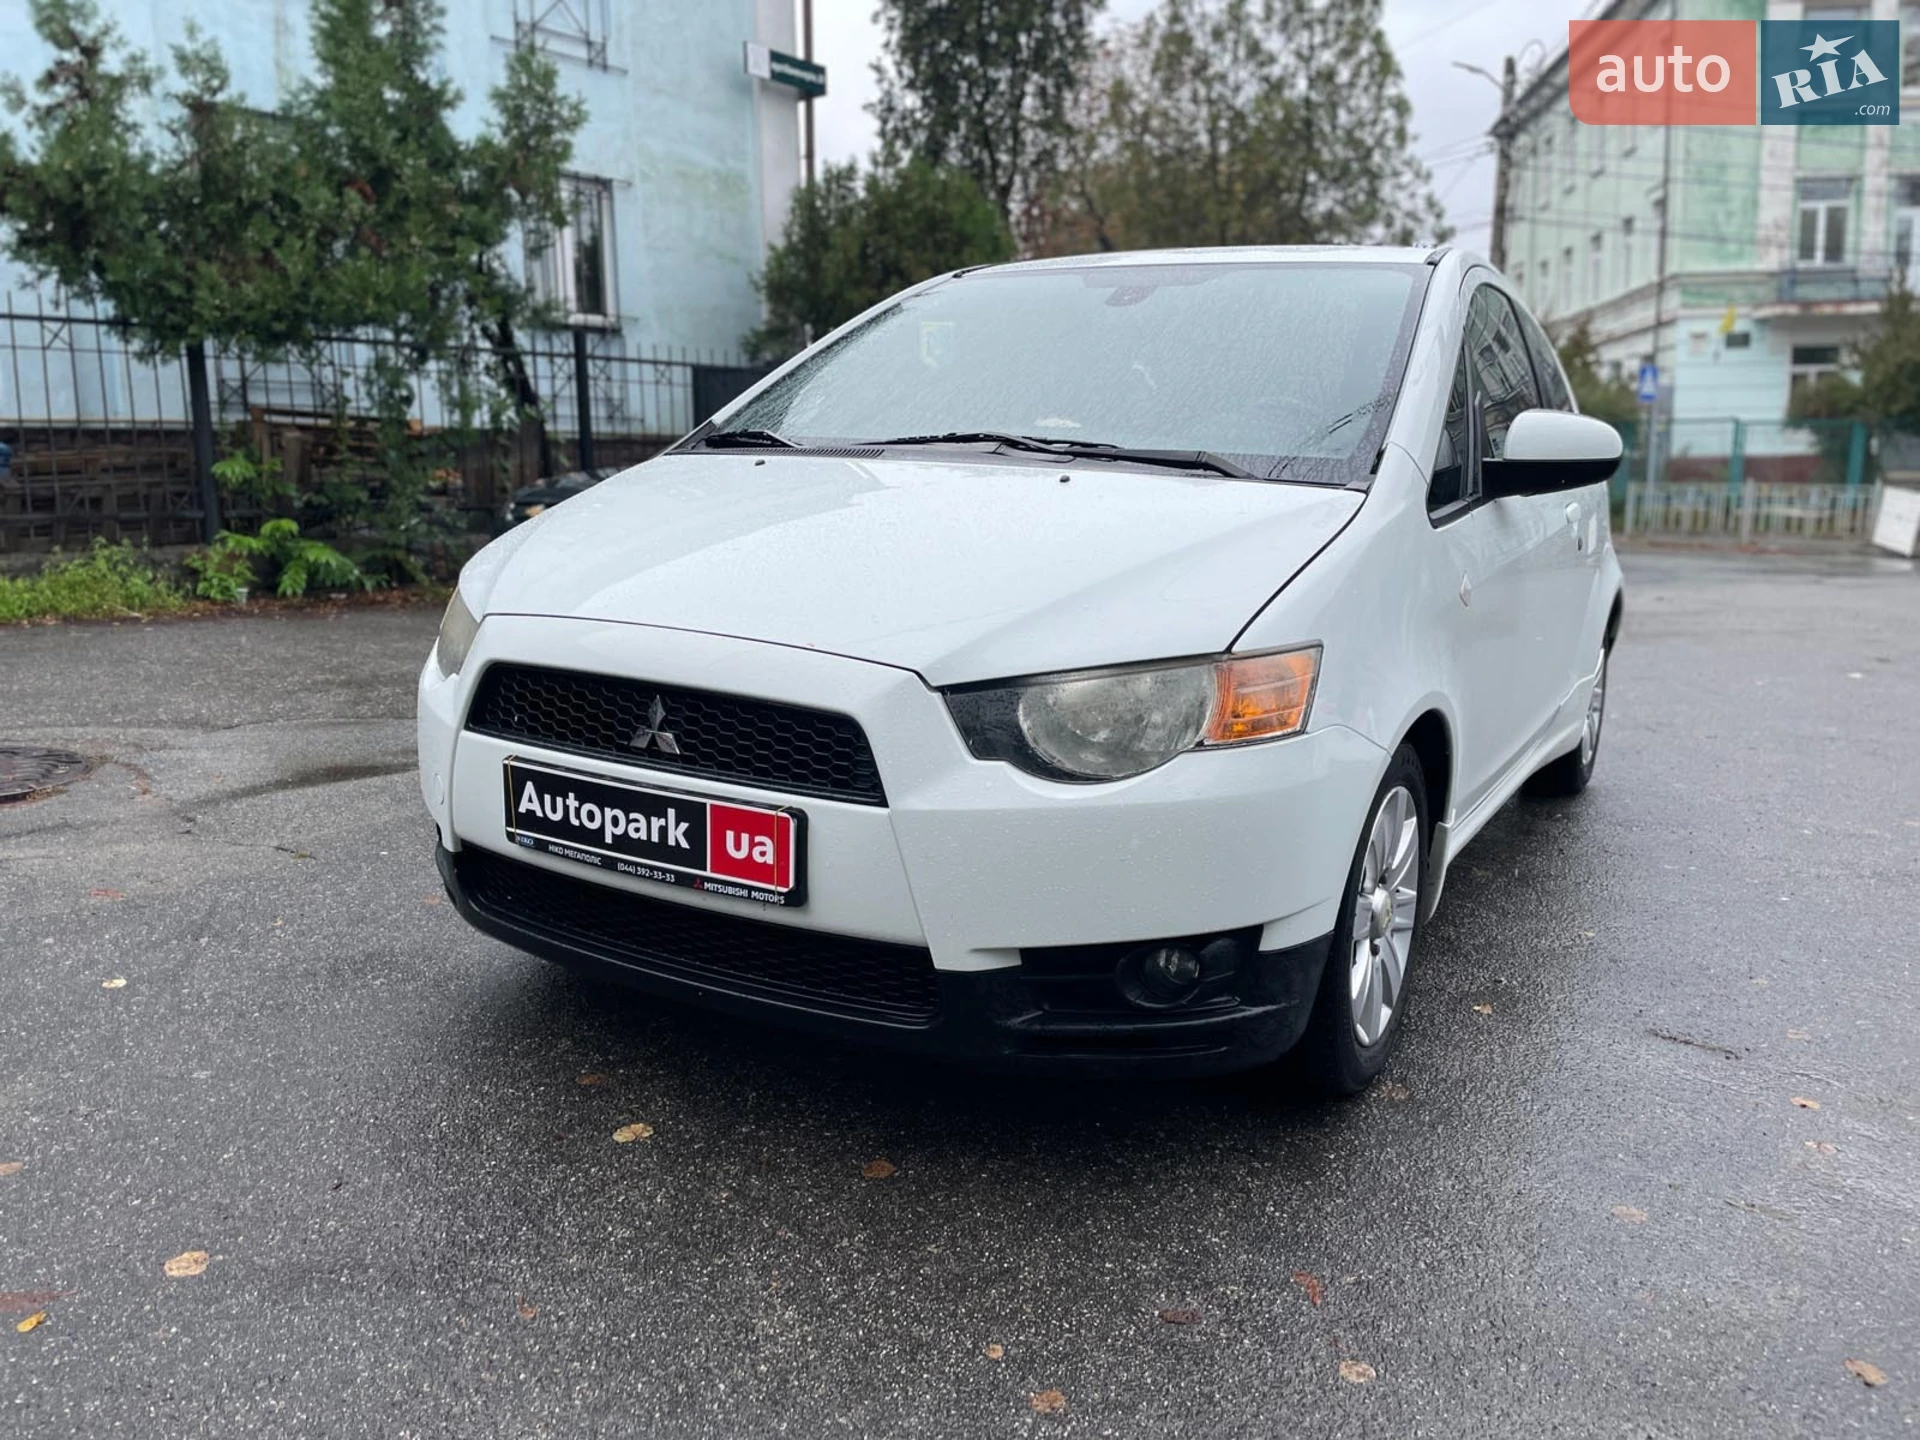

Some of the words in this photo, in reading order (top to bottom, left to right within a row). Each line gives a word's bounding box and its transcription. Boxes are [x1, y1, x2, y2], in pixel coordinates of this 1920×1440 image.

[517, 780, 690, 849] Autopark
[725, 829, 774, 865] ua
[617, 862, 636, 875] (044)
[636, 866, 675, 883] 392-33-33
[704, 881, 748, 898] MITSUBISHI
